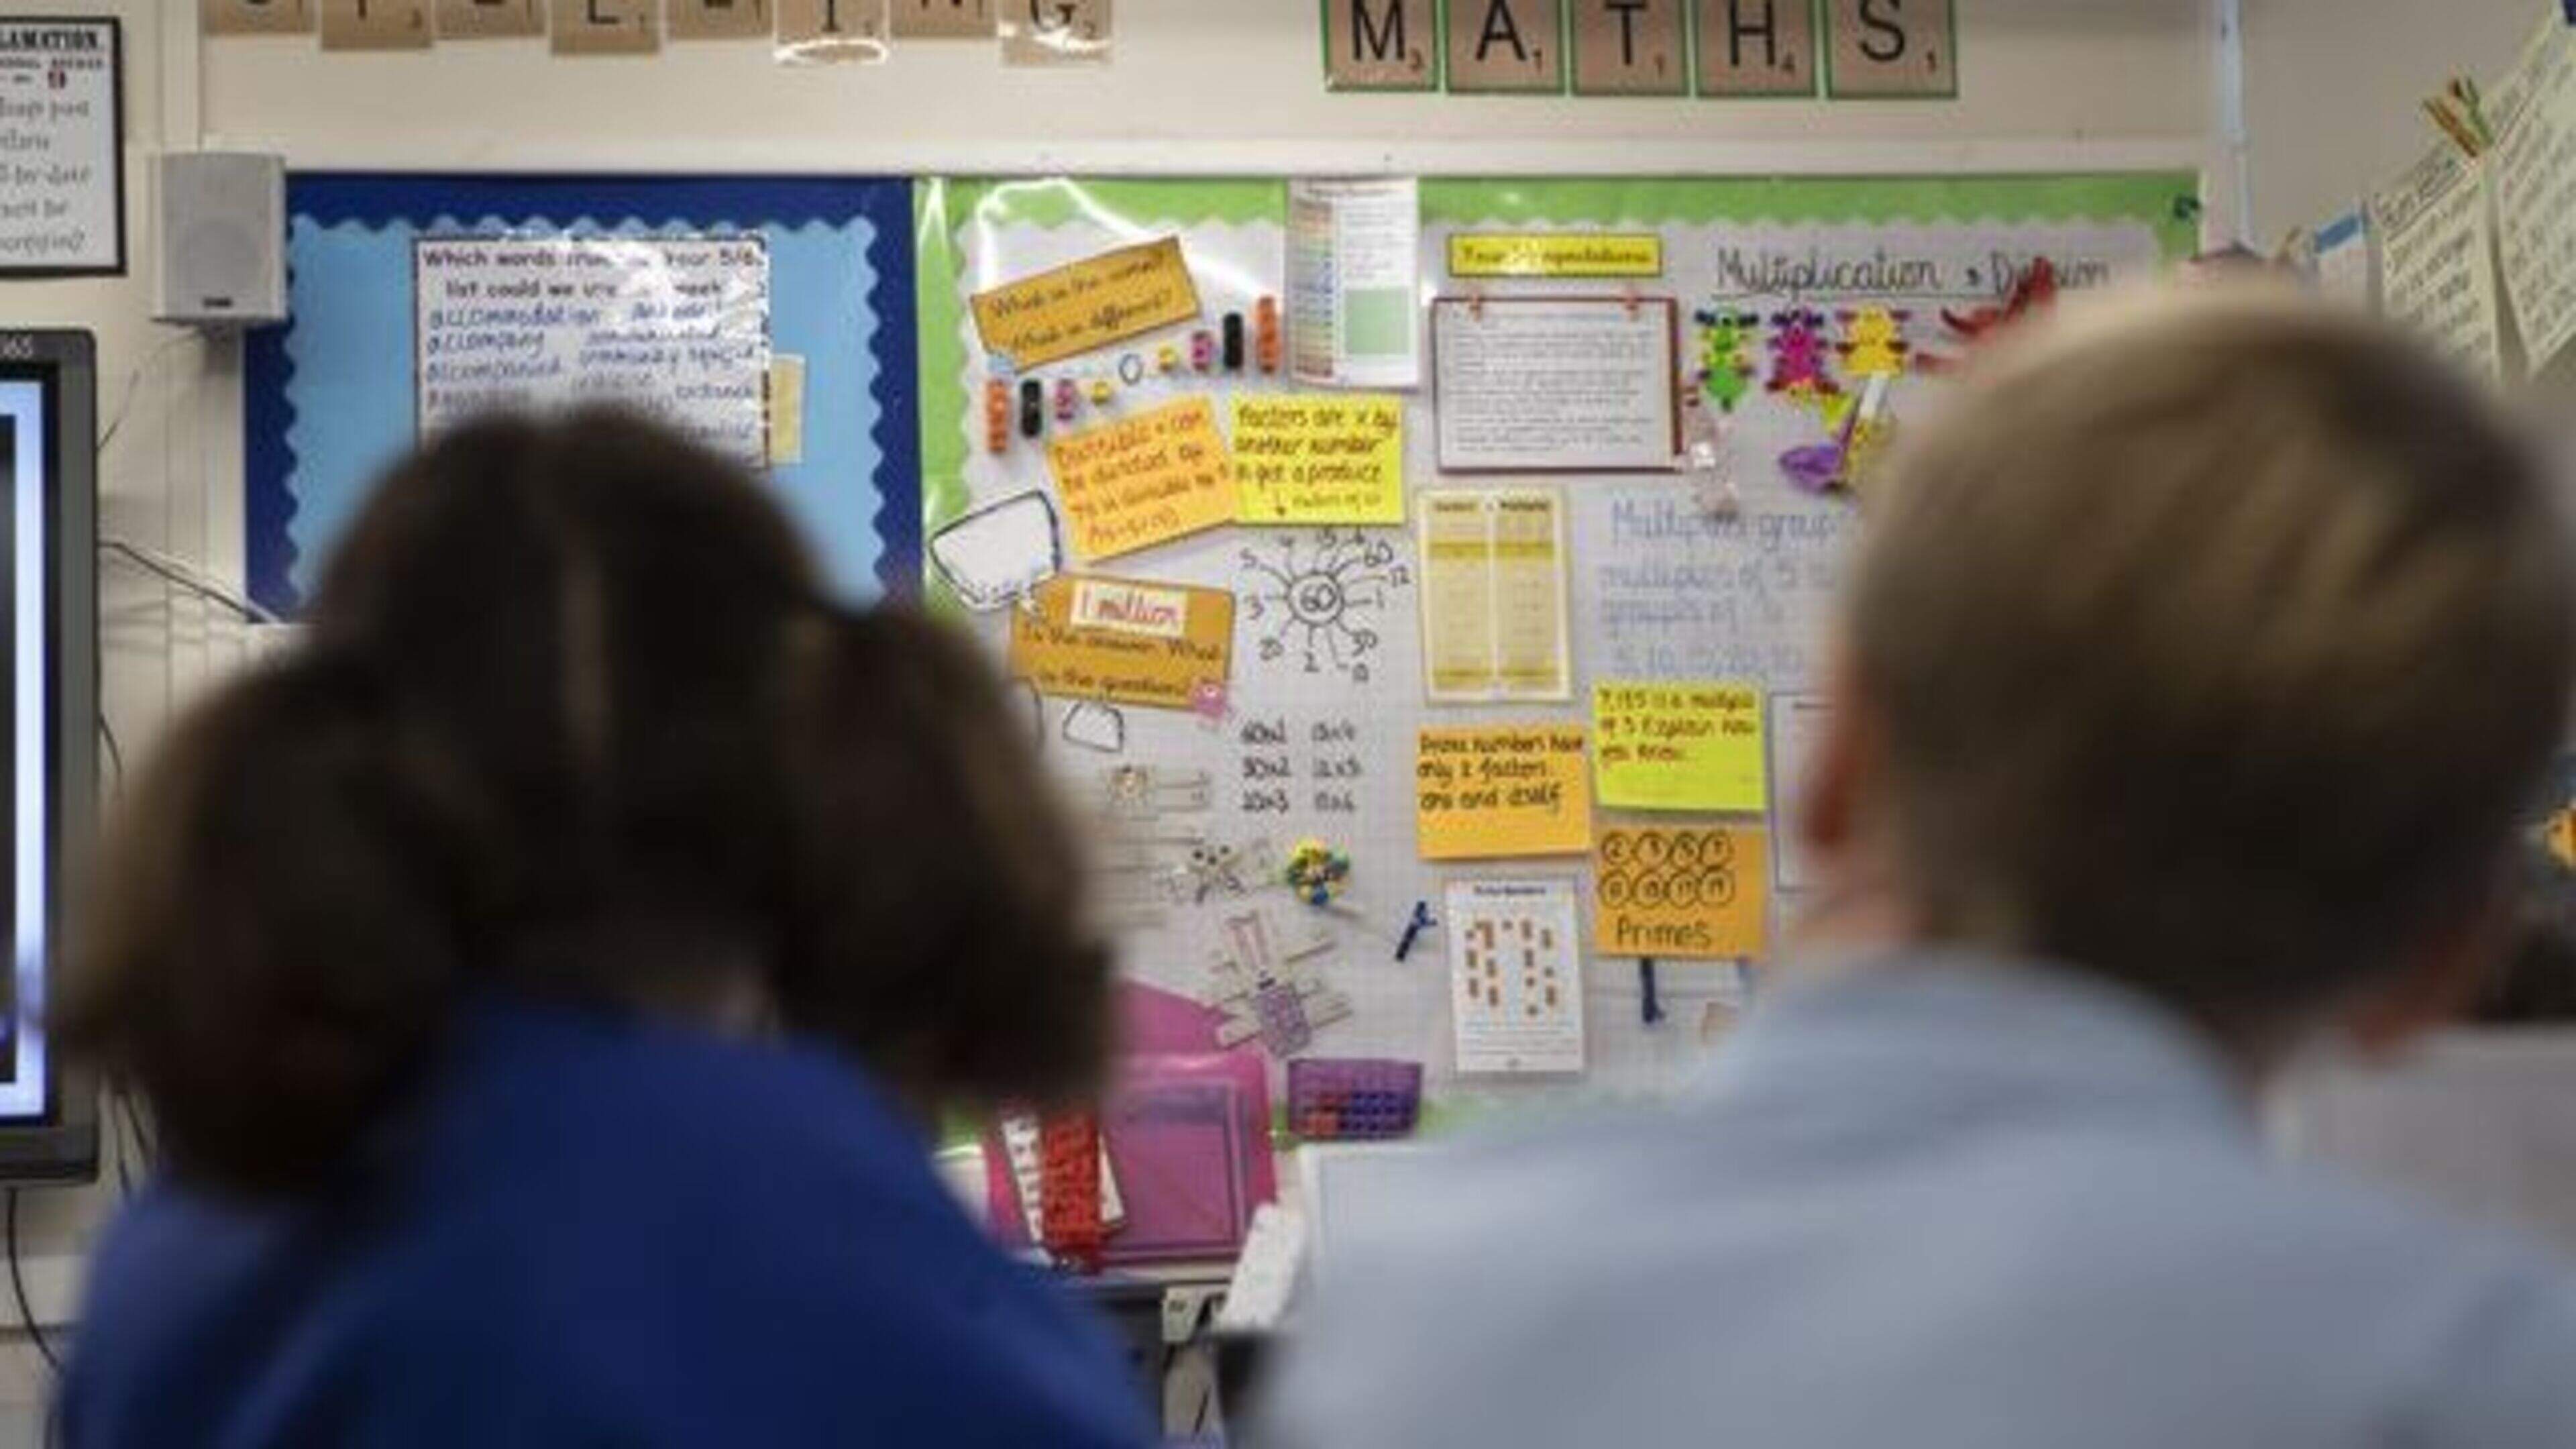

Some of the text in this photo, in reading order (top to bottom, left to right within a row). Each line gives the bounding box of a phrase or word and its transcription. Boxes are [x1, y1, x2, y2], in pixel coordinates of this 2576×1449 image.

[1350, 0, 1907, 67] MATHS
[425, 249, 487, 267] Which
[497, 248, 557, 267] words
[446, 279, 478, 298] list
[487, 279, 541, 298] could
[547, 284, 574, 297] we
[1717, 247, 1943, 302] Multiplication
[1364, 539, 1394, 569] 60
[1097, 588, 1179, 627] million
[1299, 582, 1338, 613] 60
[1459, 787, 1499, 810] and
[1616, 912, 1713, 950] Primes
